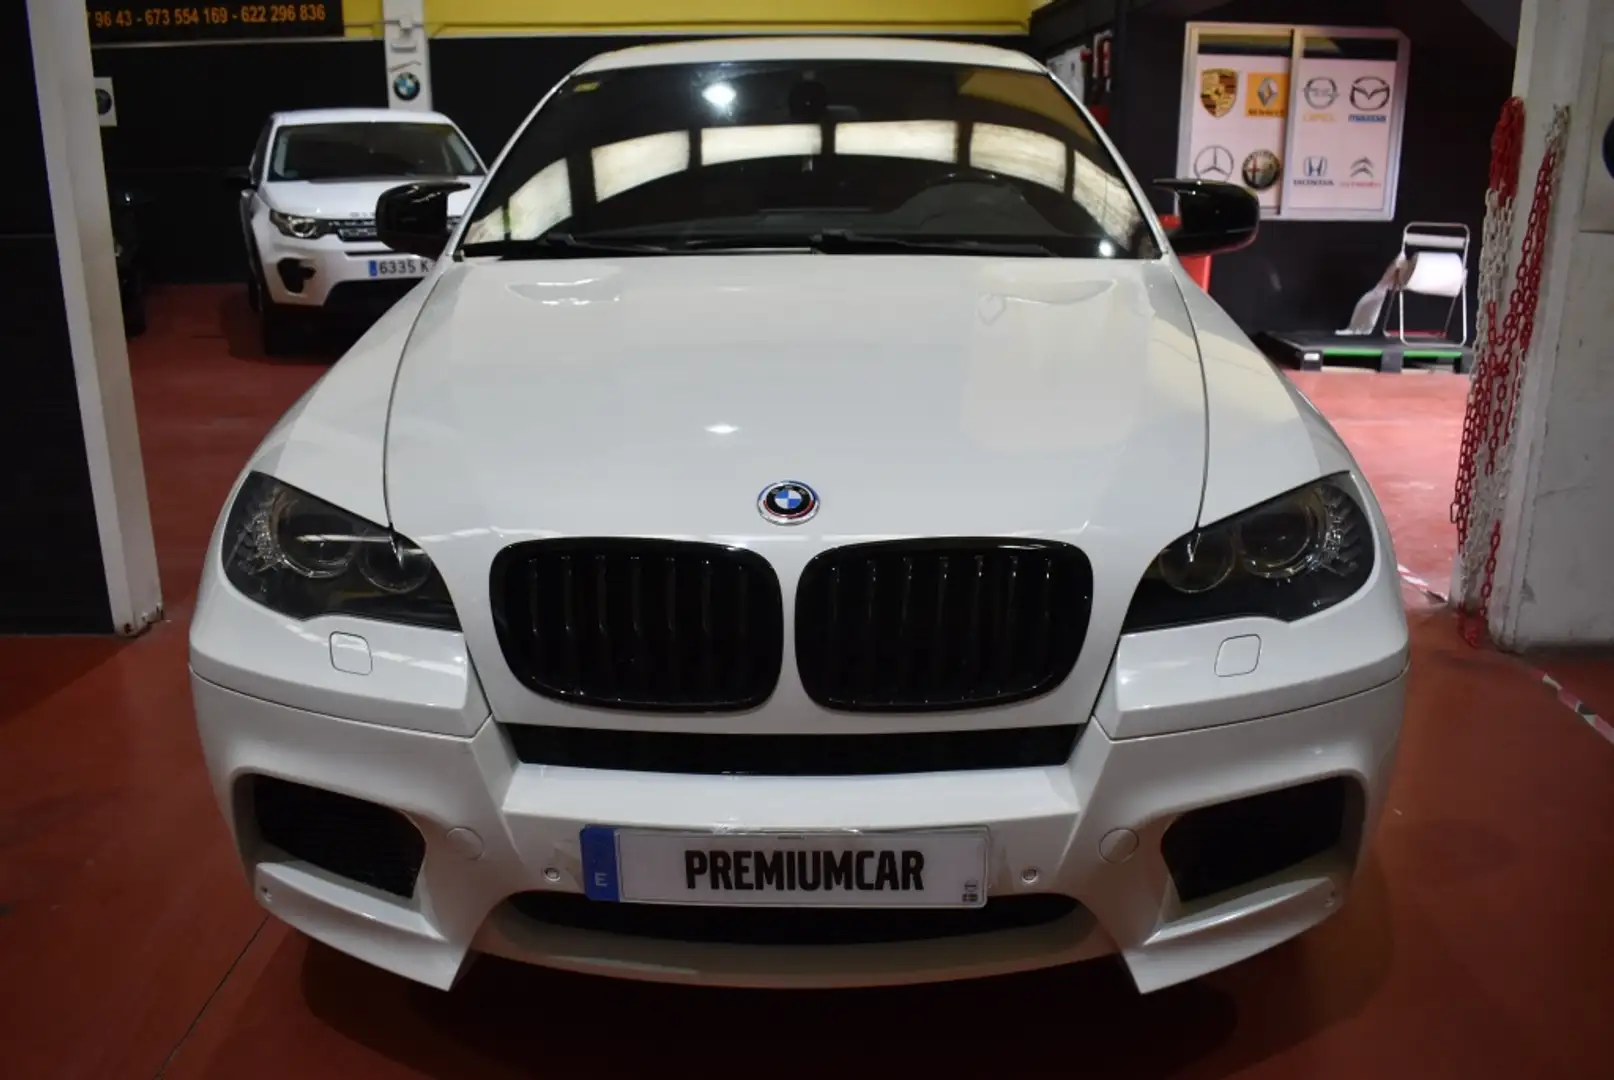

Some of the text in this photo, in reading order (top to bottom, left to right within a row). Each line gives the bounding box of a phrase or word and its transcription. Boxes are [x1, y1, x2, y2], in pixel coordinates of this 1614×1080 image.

[94, 11, 112, 28] 96
[115, 10, 132, 28] 43
[145, 8, 170, 26] 673
[174, 7, 200, 25] 554
[203, 7, 228, 24] 169
[241, 5, 267, 22] 622
[270, 4, 296, 22] 296
[299, 4, 326, 21] 836
[380, 260, 416, 275] 6335
[594, 872, 609, 887] E
[685, 849, 925, 892] PREMIUMCAR
